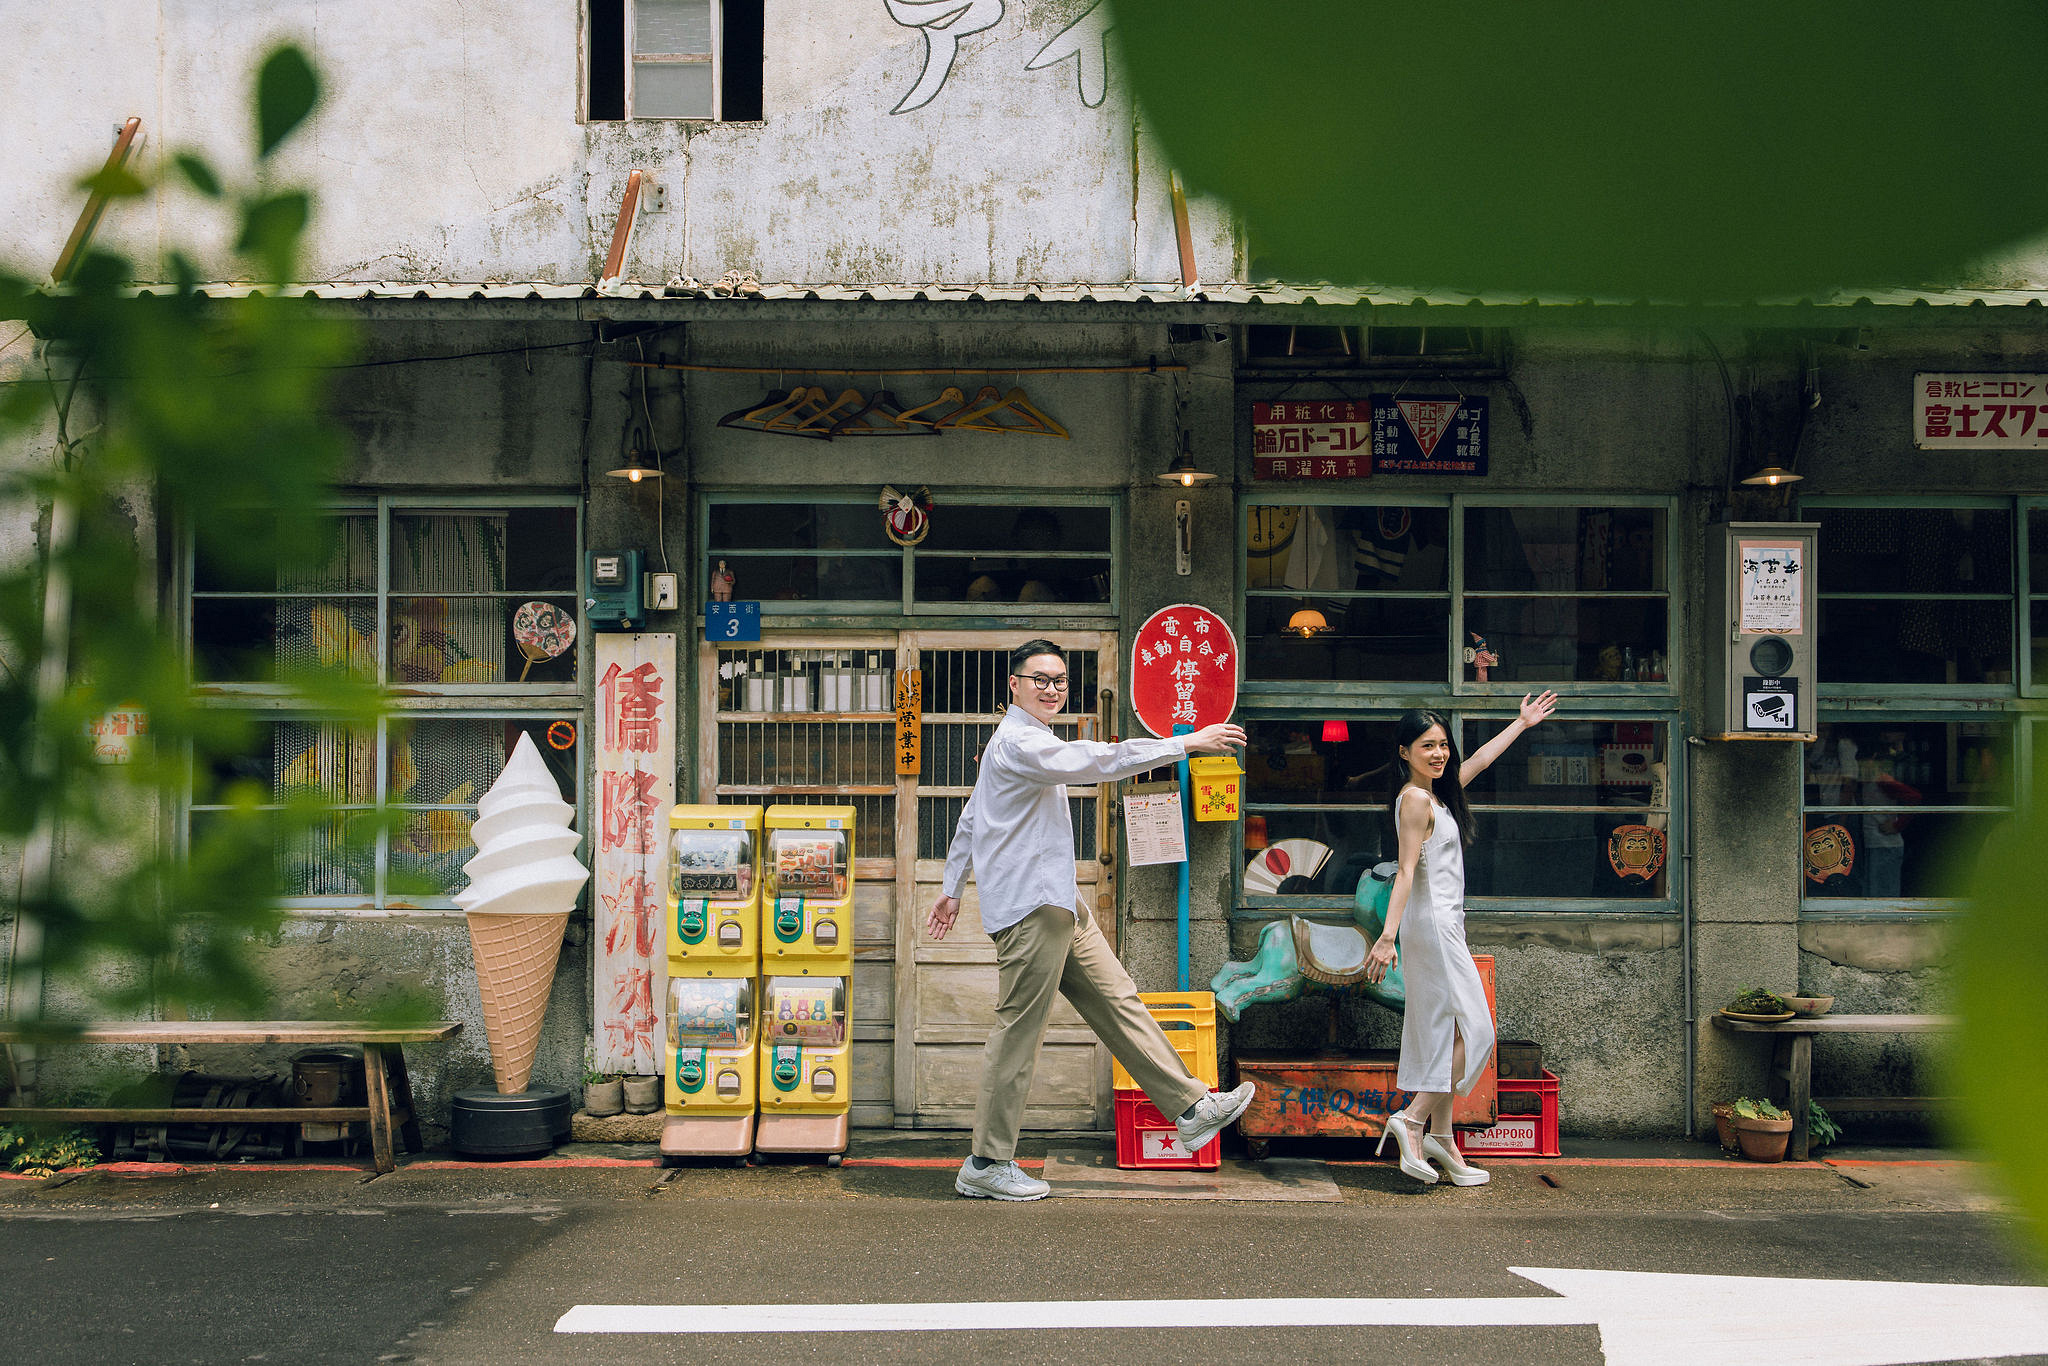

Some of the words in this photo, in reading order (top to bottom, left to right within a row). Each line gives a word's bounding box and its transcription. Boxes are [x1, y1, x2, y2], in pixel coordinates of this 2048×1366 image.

[1925, 381, 2036, 398] 倉敷ビニロン
[1374, 408, 1386, 455] 地下足袋
[1420, 404, 1436, 449] ホテイ
[726, 618, 740, 637] 3
[1170, 658, 1200, 724] 停留場
[1201, 803, 1237, 814] 牛乳
[1480, 1128, 1533, 1139] SAPPORO
